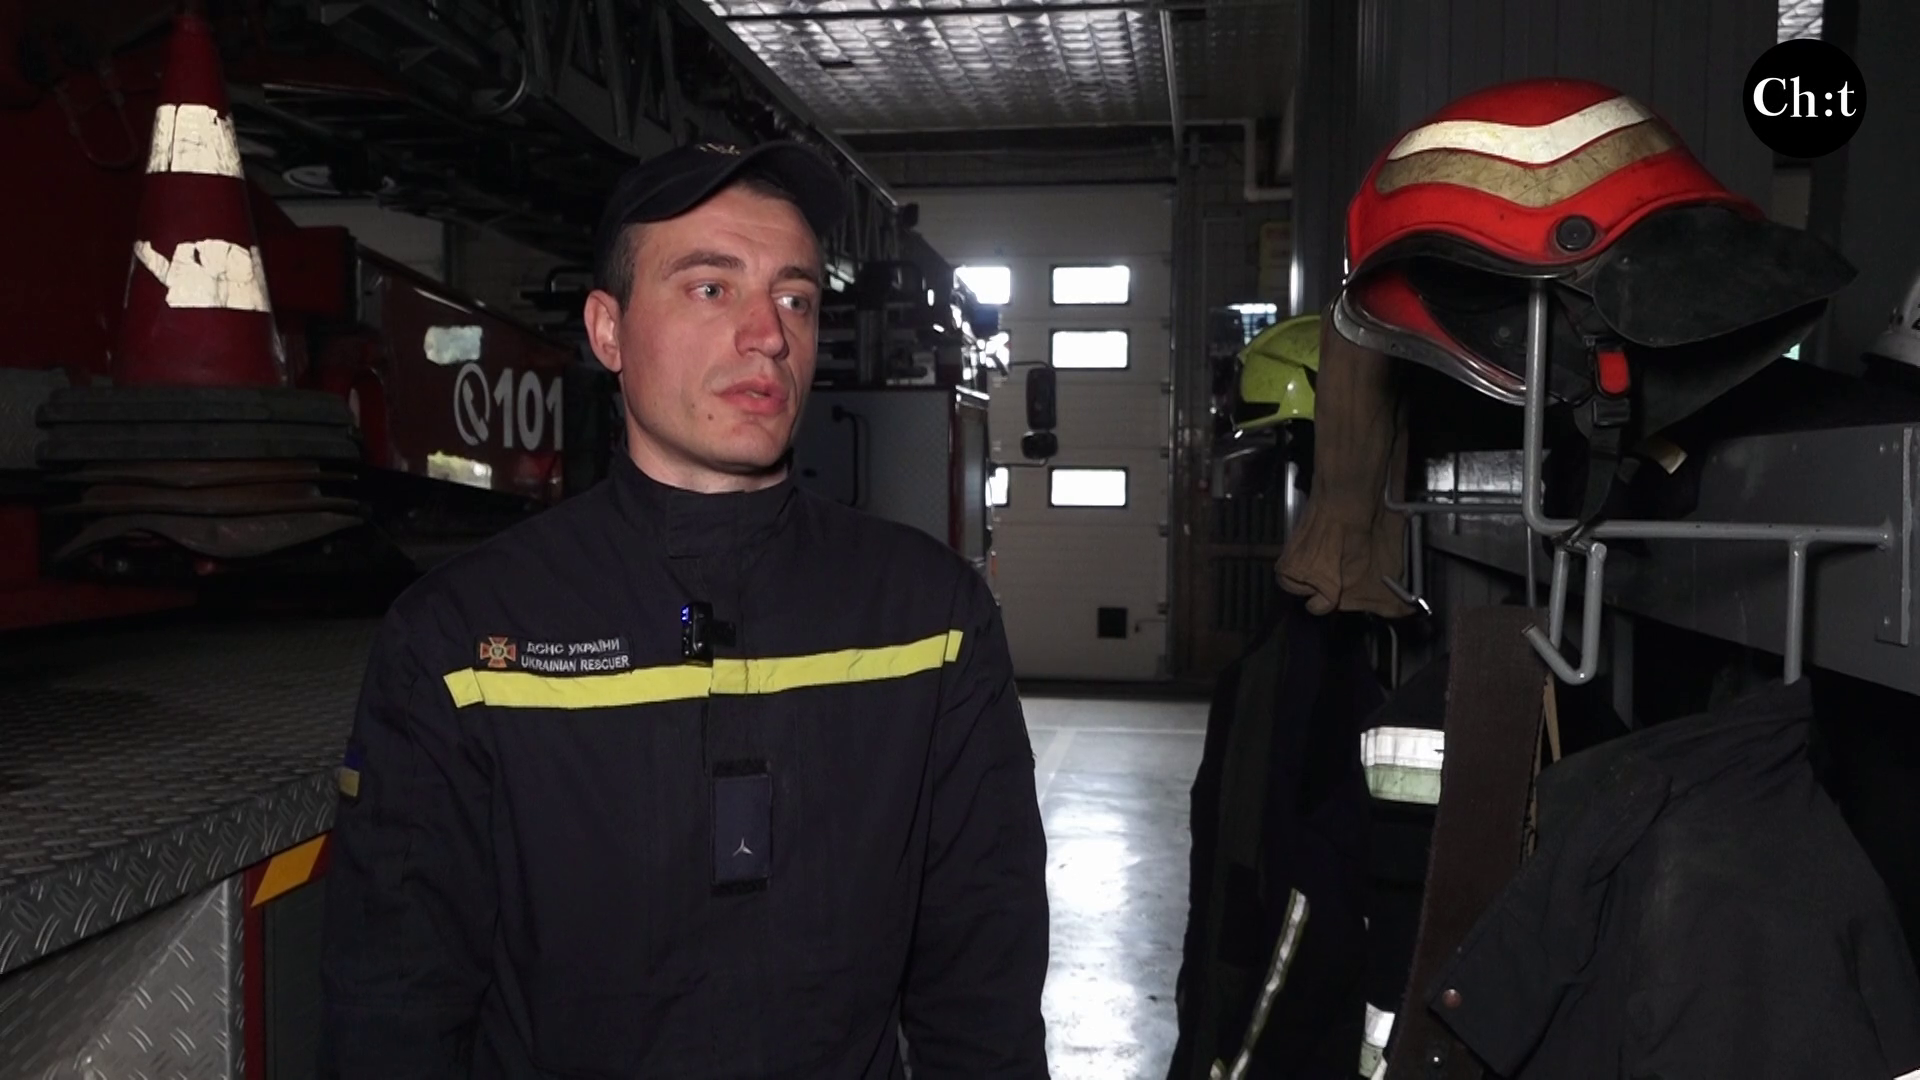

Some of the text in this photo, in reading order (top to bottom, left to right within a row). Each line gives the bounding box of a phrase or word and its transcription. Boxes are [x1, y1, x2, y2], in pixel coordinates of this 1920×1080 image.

[493, 367, 563, 451] 101
[526, 637, 620, 656] ДСНС УКРАЇНИ
[521, 655, 630, 672] UKRAINIAN RESCUER
